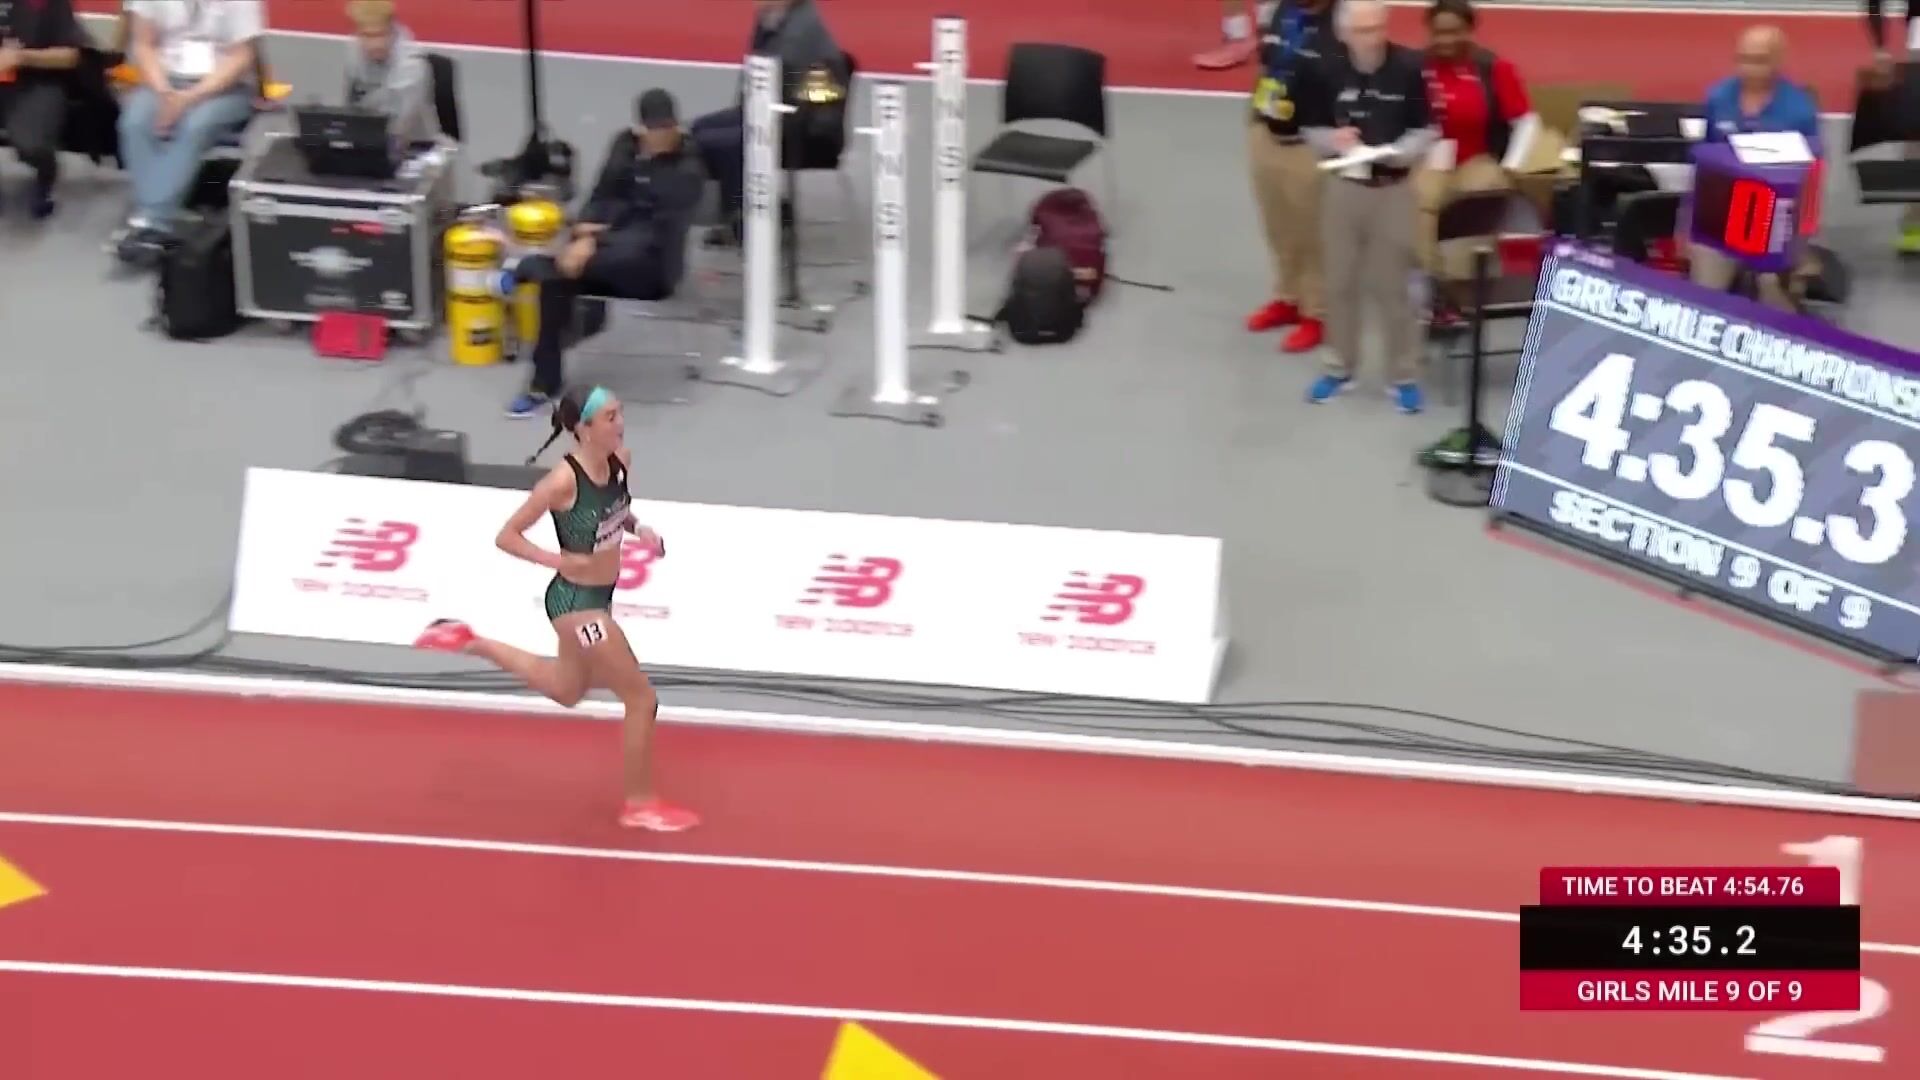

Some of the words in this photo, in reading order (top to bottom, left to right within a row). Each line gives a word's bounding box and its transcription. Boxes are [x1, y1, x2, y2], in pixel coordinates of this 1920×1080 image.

[1552, 268, 1646, 323] GIRLS
[1641, 297, 1727, 352] MILE
[1548, 352, 1917, 566] 4:35.3
[1549, 490, 1726, 579] SECTION
[1728, 555, 1761, 589] 9
[1767, 568, 1833, 612] OF
[1838, 595, 1872, 629] 9
[580, 622, 603, 645] 13
